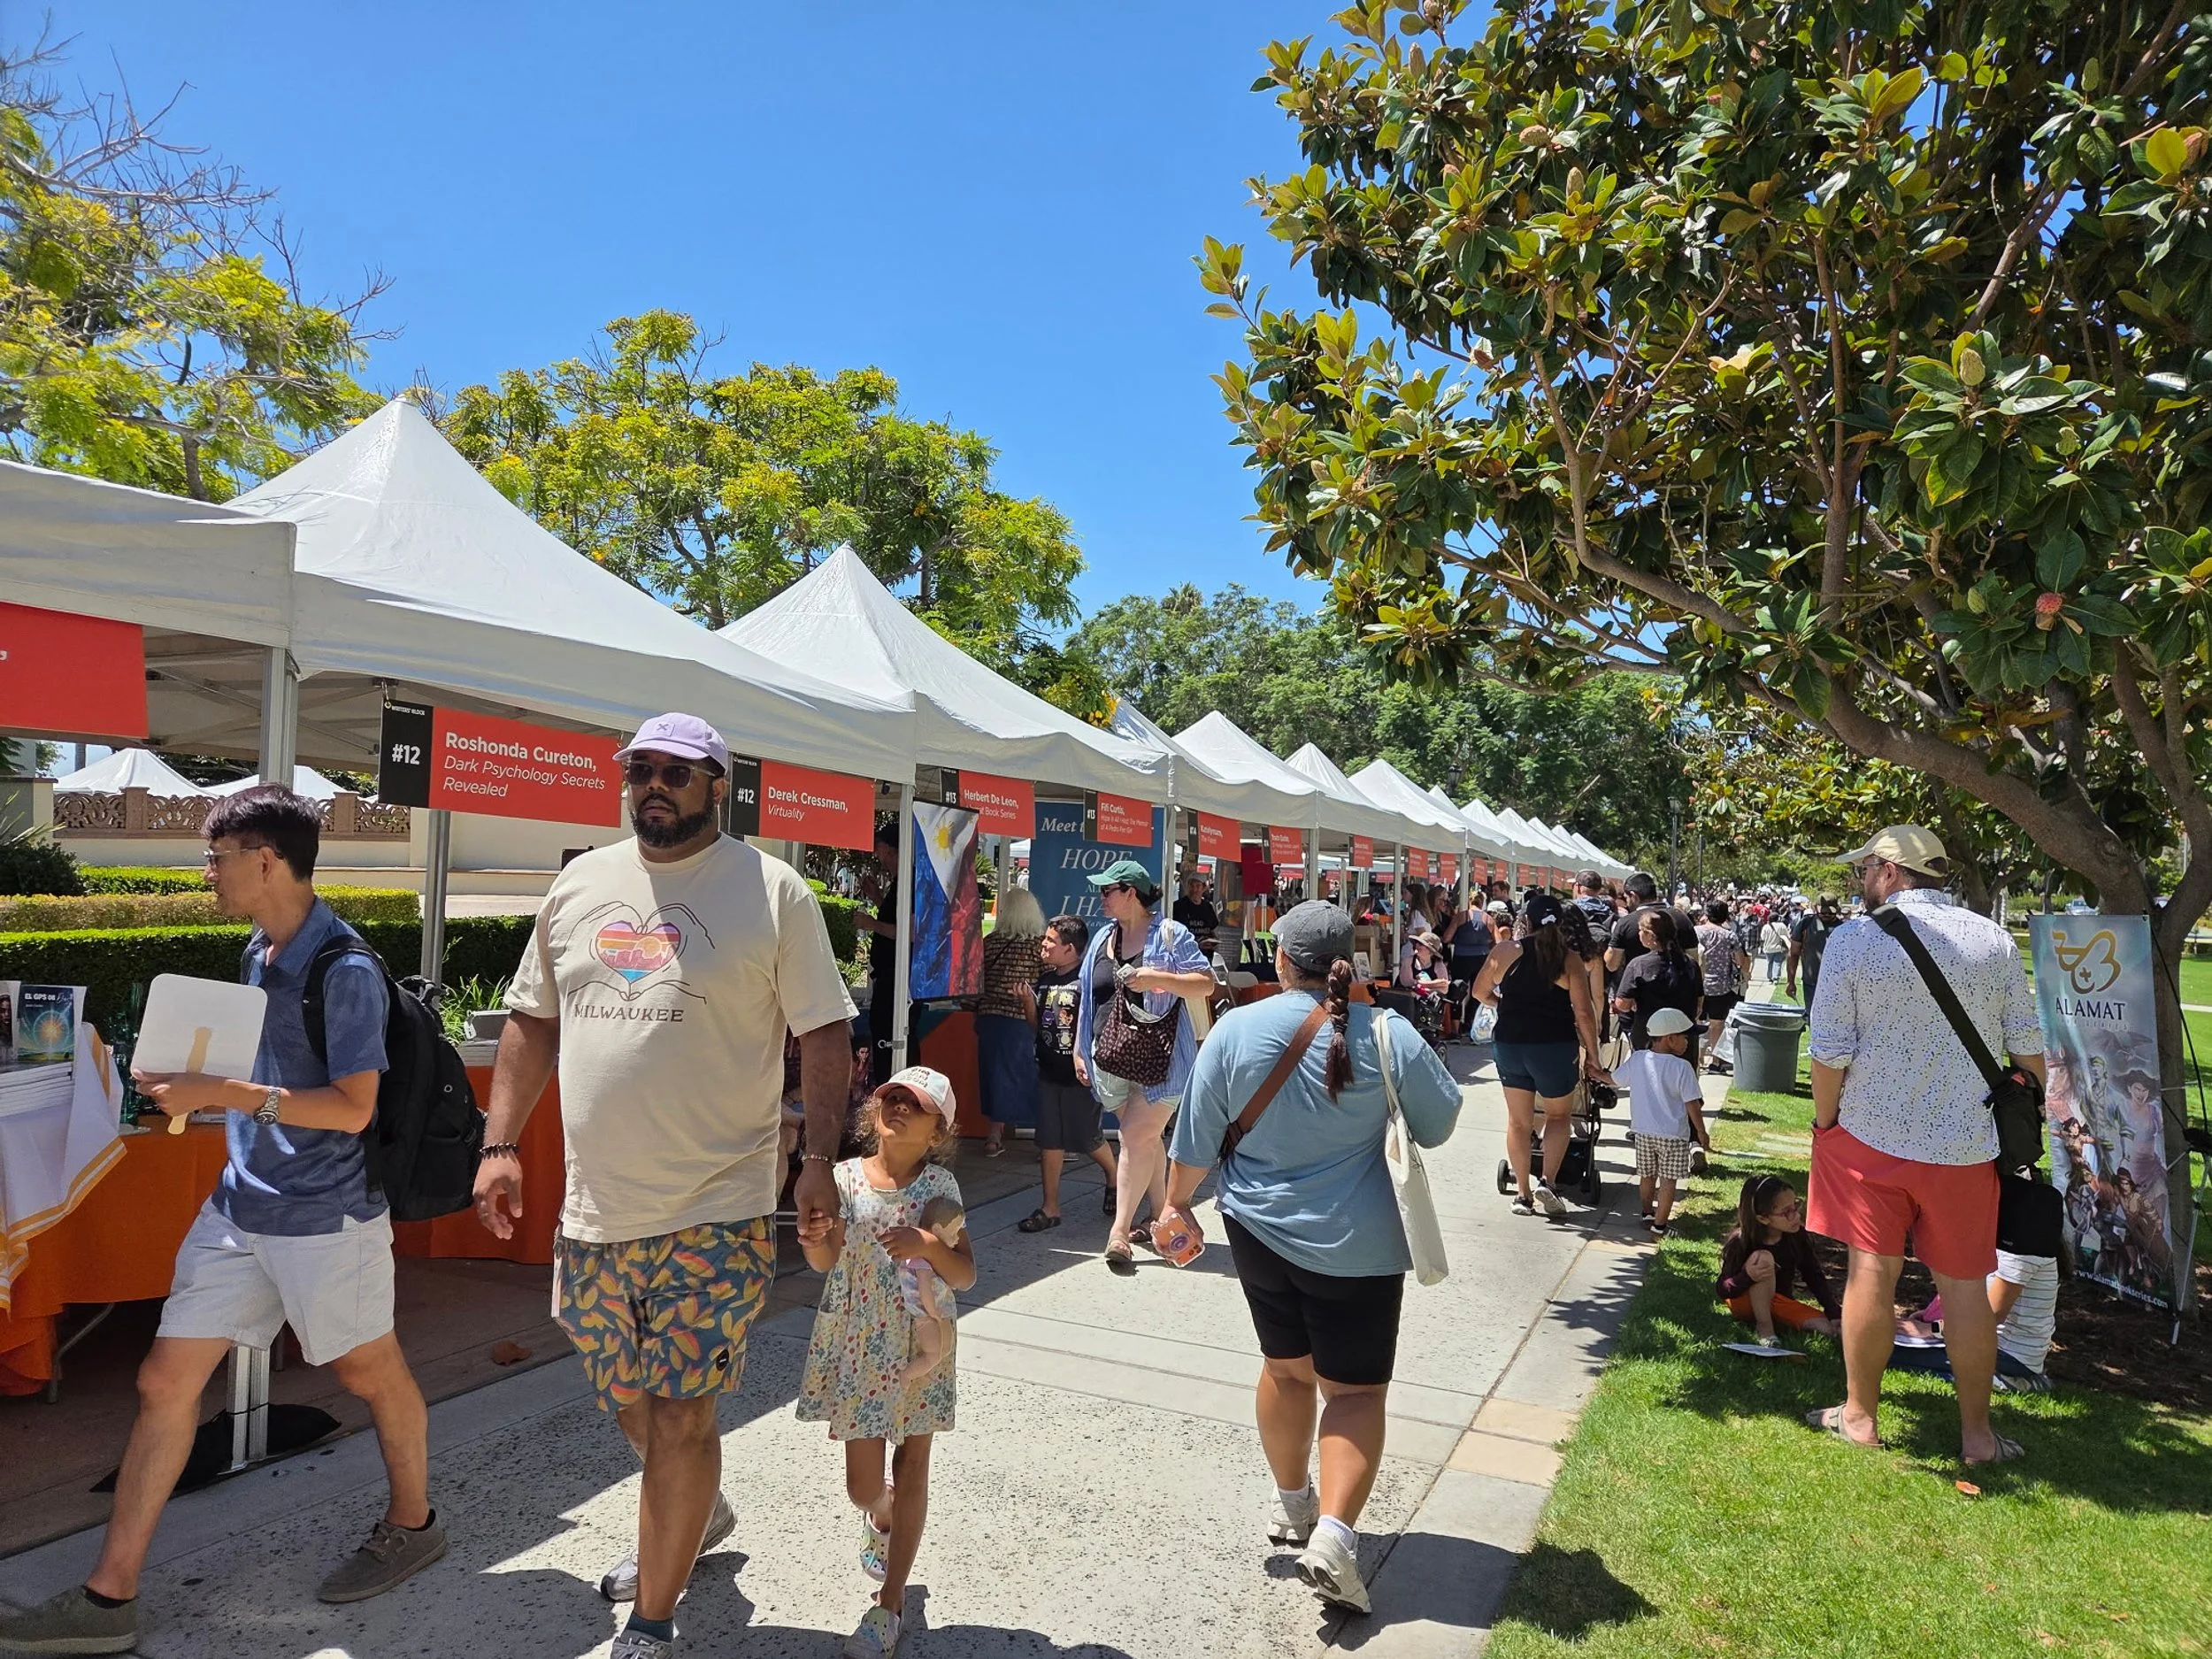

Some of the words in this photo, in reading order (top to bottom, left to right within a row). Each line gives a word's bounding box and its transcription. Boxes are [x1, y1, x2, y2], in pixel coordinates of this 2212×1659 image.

[391, 743, 421, 765] #12
[445, 732, 528, 759] Roshonda
[533, 746, 597, 772] Cureton,
[444, 756, 480, 773] Dark
[481, 760, 557, 785] Psychology
[560, 772, 606, 789] Secrets
[442, 777, 509, 797] Revealed
[737, 787, 755, 804] #12
[768, 786, 798, 803] Derek
[801, 792, 849, 813] Cressman,
[945, 791, 956, 804] #13
[964, 789, 990, 803] Herbert
[991, 794, 1000, 804] De
[1001, 796, 1019, 809] Leon,
[768, 804, 805, 822] Virtuality
[986, 806, 1000, 817] Book
[1001, 809, 1017, 819] Series
[1087, 809, 1095, 820] #13
[1110, 803, 1125, 816] Curtis,
[1041, 818, 1077, 833] Meet
[1058, 895, 1071, 916] I
[574, 1004, 684, 1023] MILWAUKEE
[2055, 997, 2126, 1020] ALAMAT
